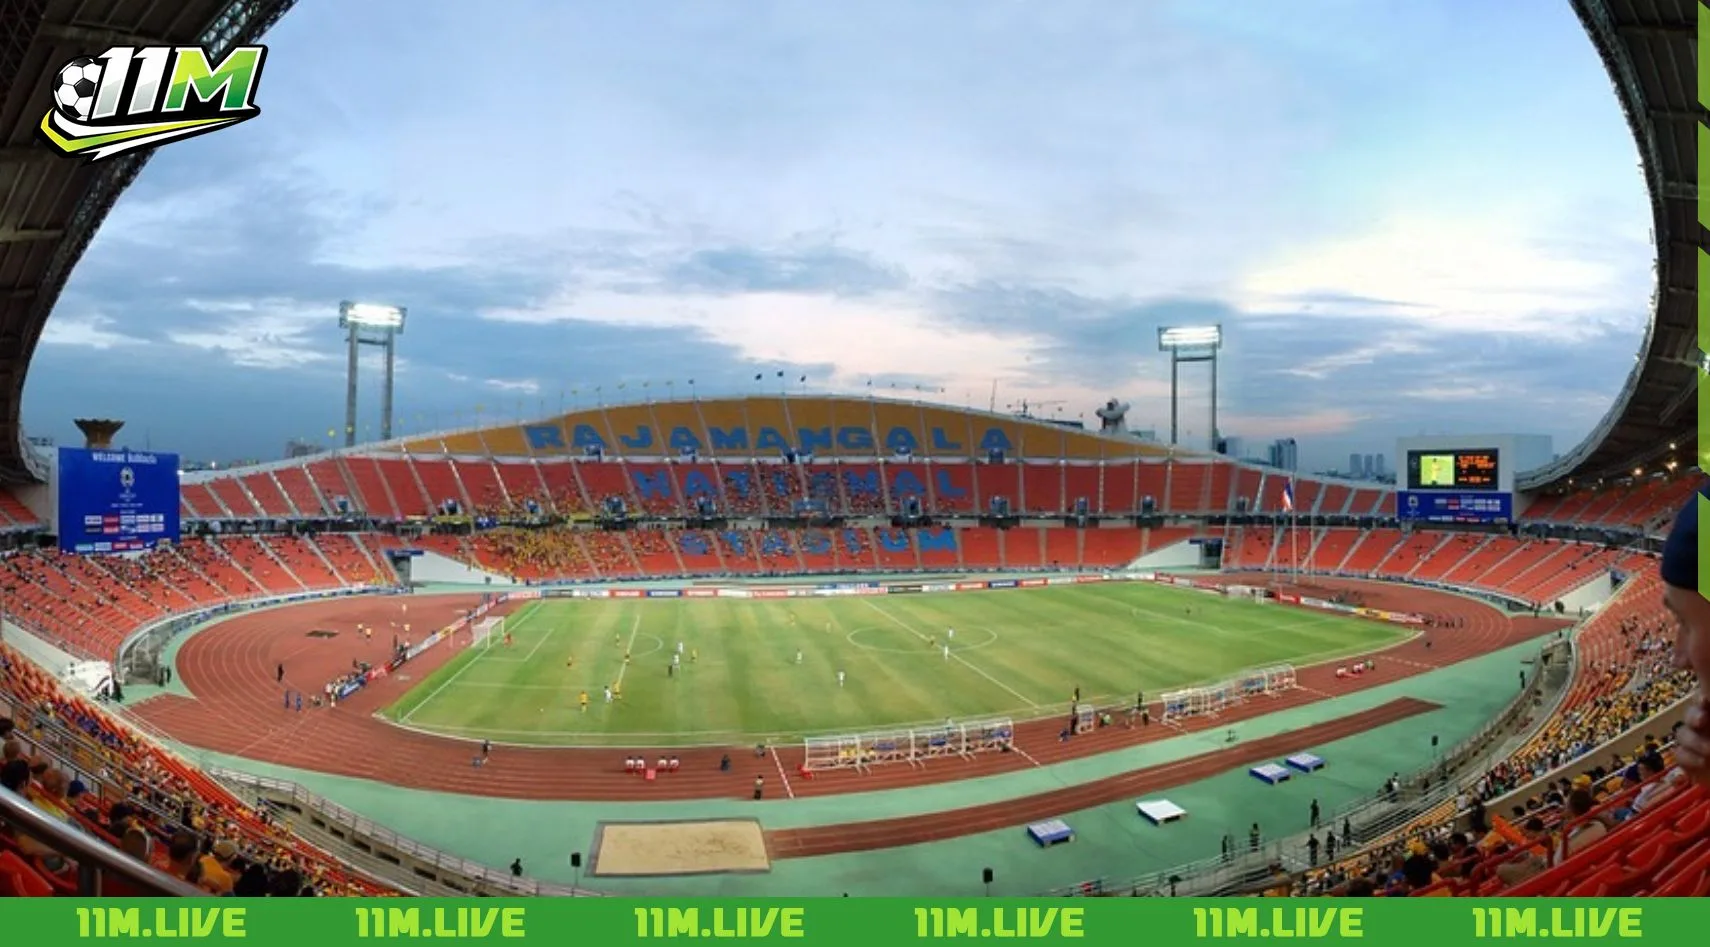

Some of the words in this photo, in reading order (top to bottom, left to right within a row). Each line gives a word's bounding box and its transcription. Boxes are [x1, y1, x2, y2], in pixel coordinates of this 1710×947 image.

[526, 424, 1013, 450] RAJAMANGALA
[635, 470, 967, 498] NATIONAL
[681, 529, 958, 555] STADIUM
